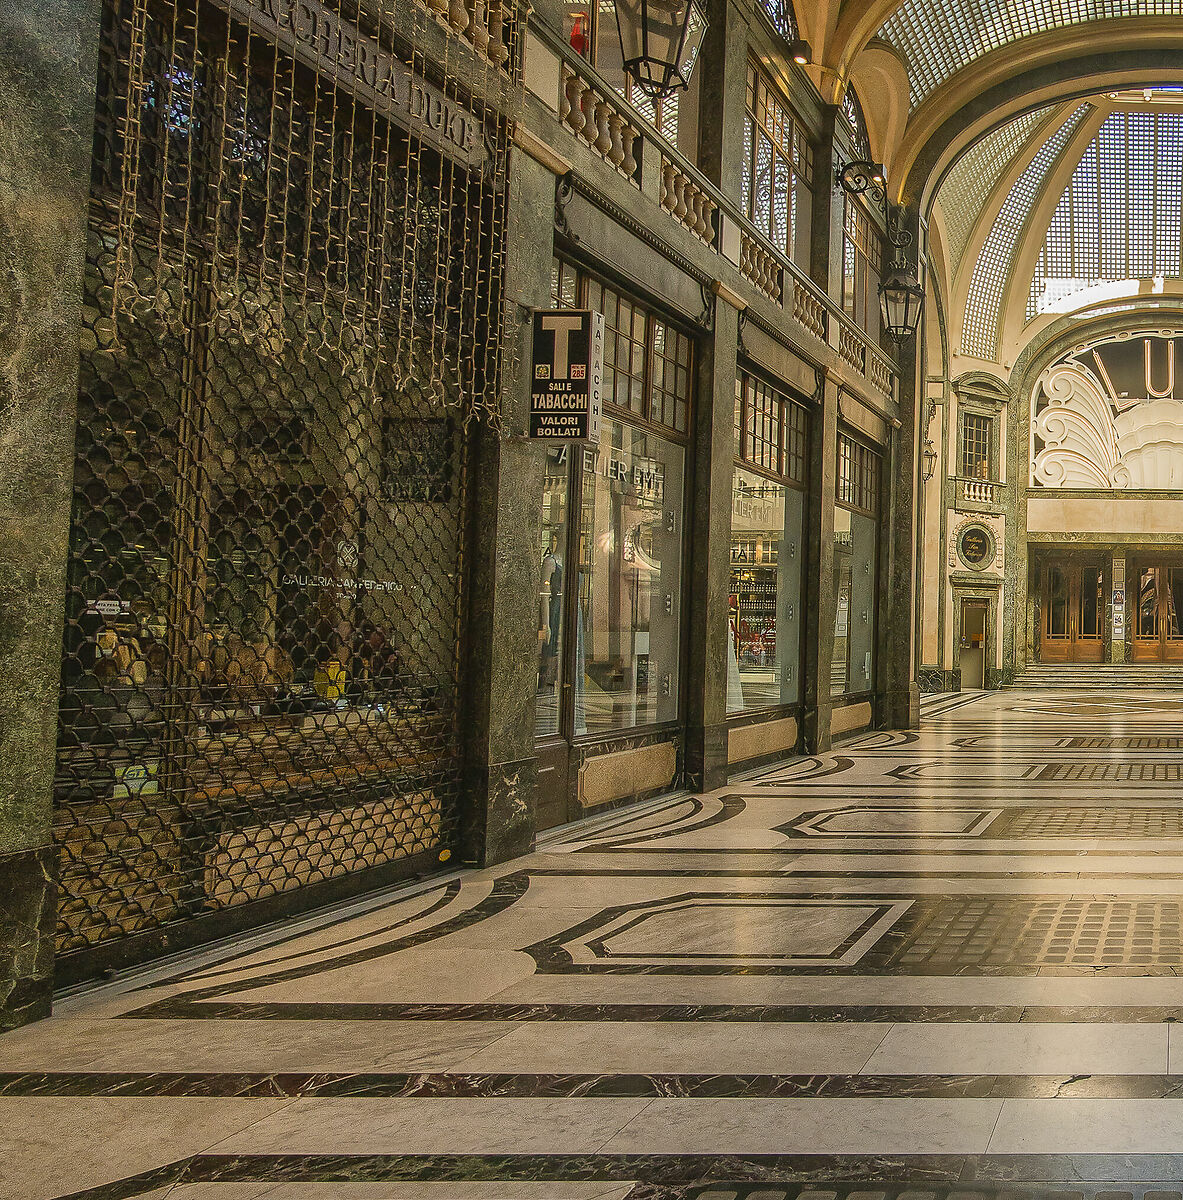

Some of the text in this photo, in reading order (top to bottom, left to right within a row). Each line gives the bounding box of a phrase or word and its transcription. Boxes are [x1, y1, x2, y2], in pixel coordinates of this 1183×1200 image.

[409, 80, 474, 150] DUKE
[542, 316, 582, 379] T
[572, 370, 585, 378] 285
[549, 382, 572, 391] SALI E
[532, 393, 588, 409] TABACCHI
[540, 416, 578, 425] VALORI
[537, 428, 581, 437] BOLLATI
